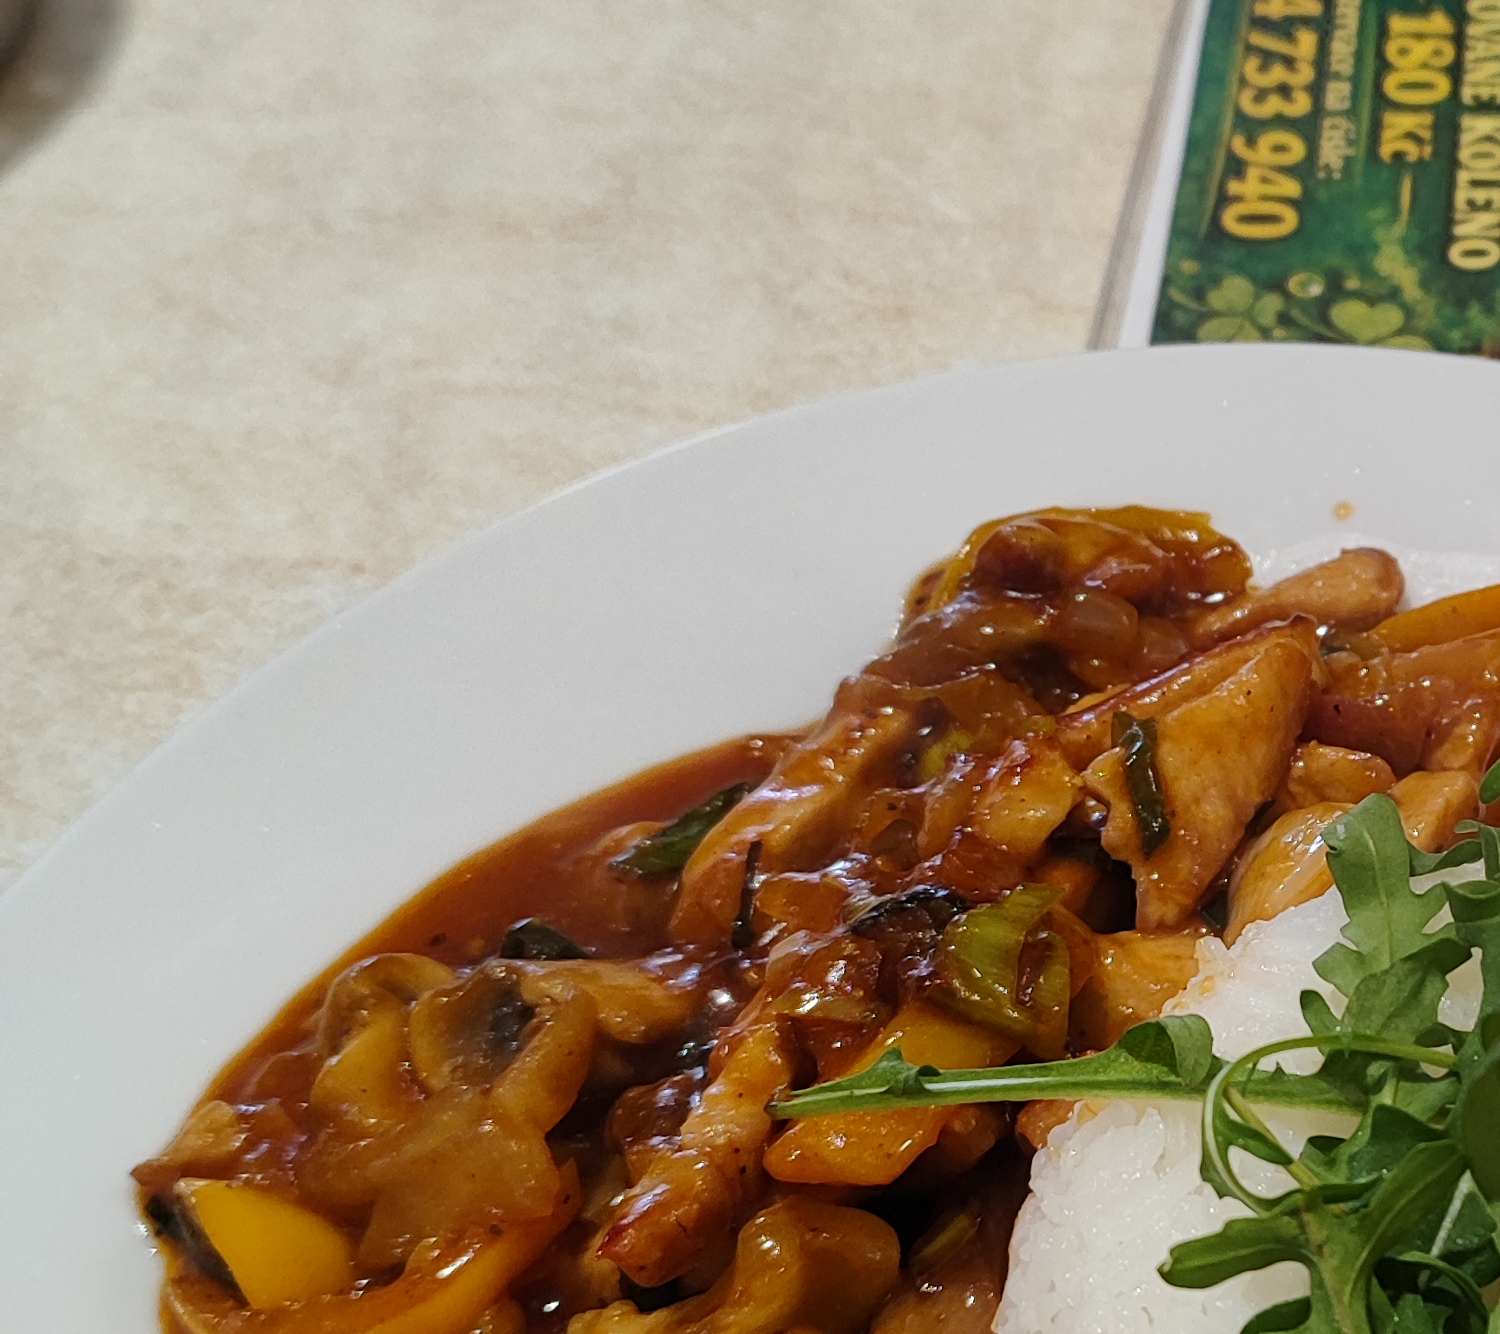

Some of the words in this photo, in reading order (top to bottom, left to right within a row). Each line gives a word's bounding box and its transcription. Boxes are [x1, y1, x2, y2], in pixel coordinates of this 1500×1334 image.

[1237, 26, 1319, 119] 733
[1324, 80, 1352, 111] na
[1382, 5, 1456, 105] 180
[1378, 111, 1434, 164] Kč
[1220, 129, 1308, 241] 940
